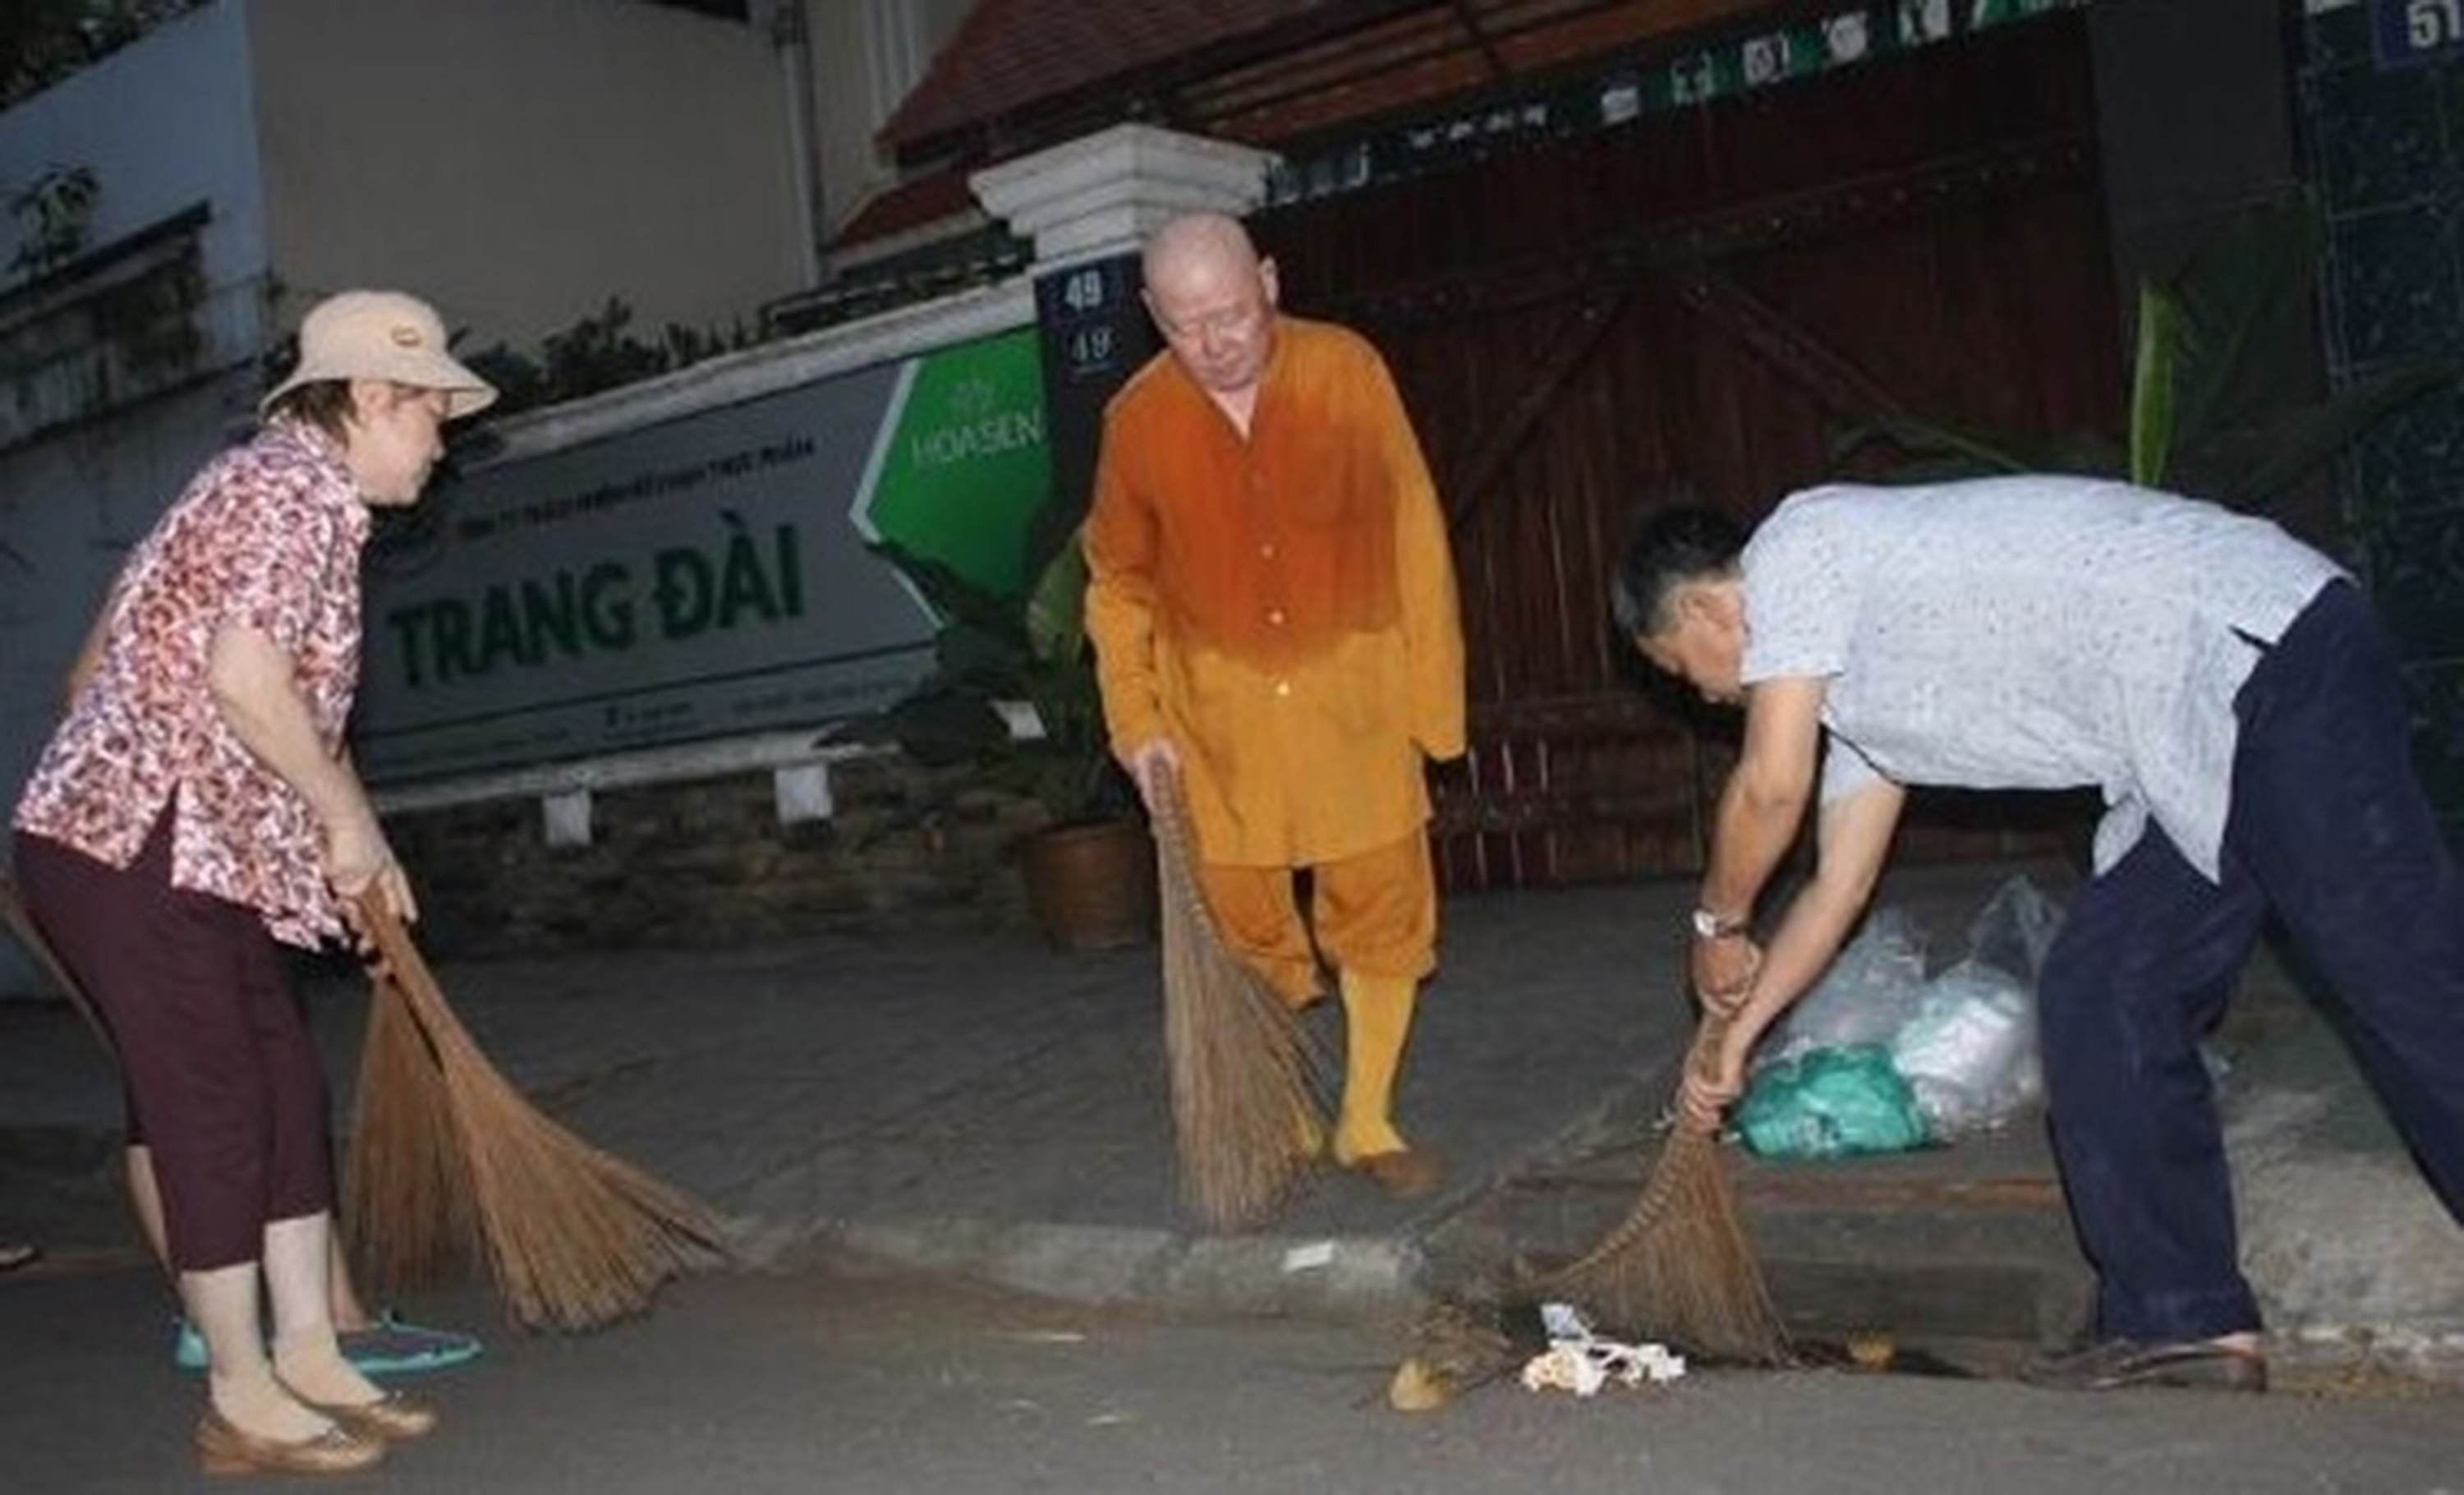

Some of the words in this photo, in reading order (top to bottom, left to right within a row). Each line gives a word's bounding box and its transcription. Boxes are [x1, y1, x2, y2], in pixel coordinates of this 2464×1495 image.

[2404, 0, 2462, 51] 51
[1065, 269, 1102, 310] 49
[388, 559, 637, 688] TRANG
[653, 508, 805, 639] ĐÀI
